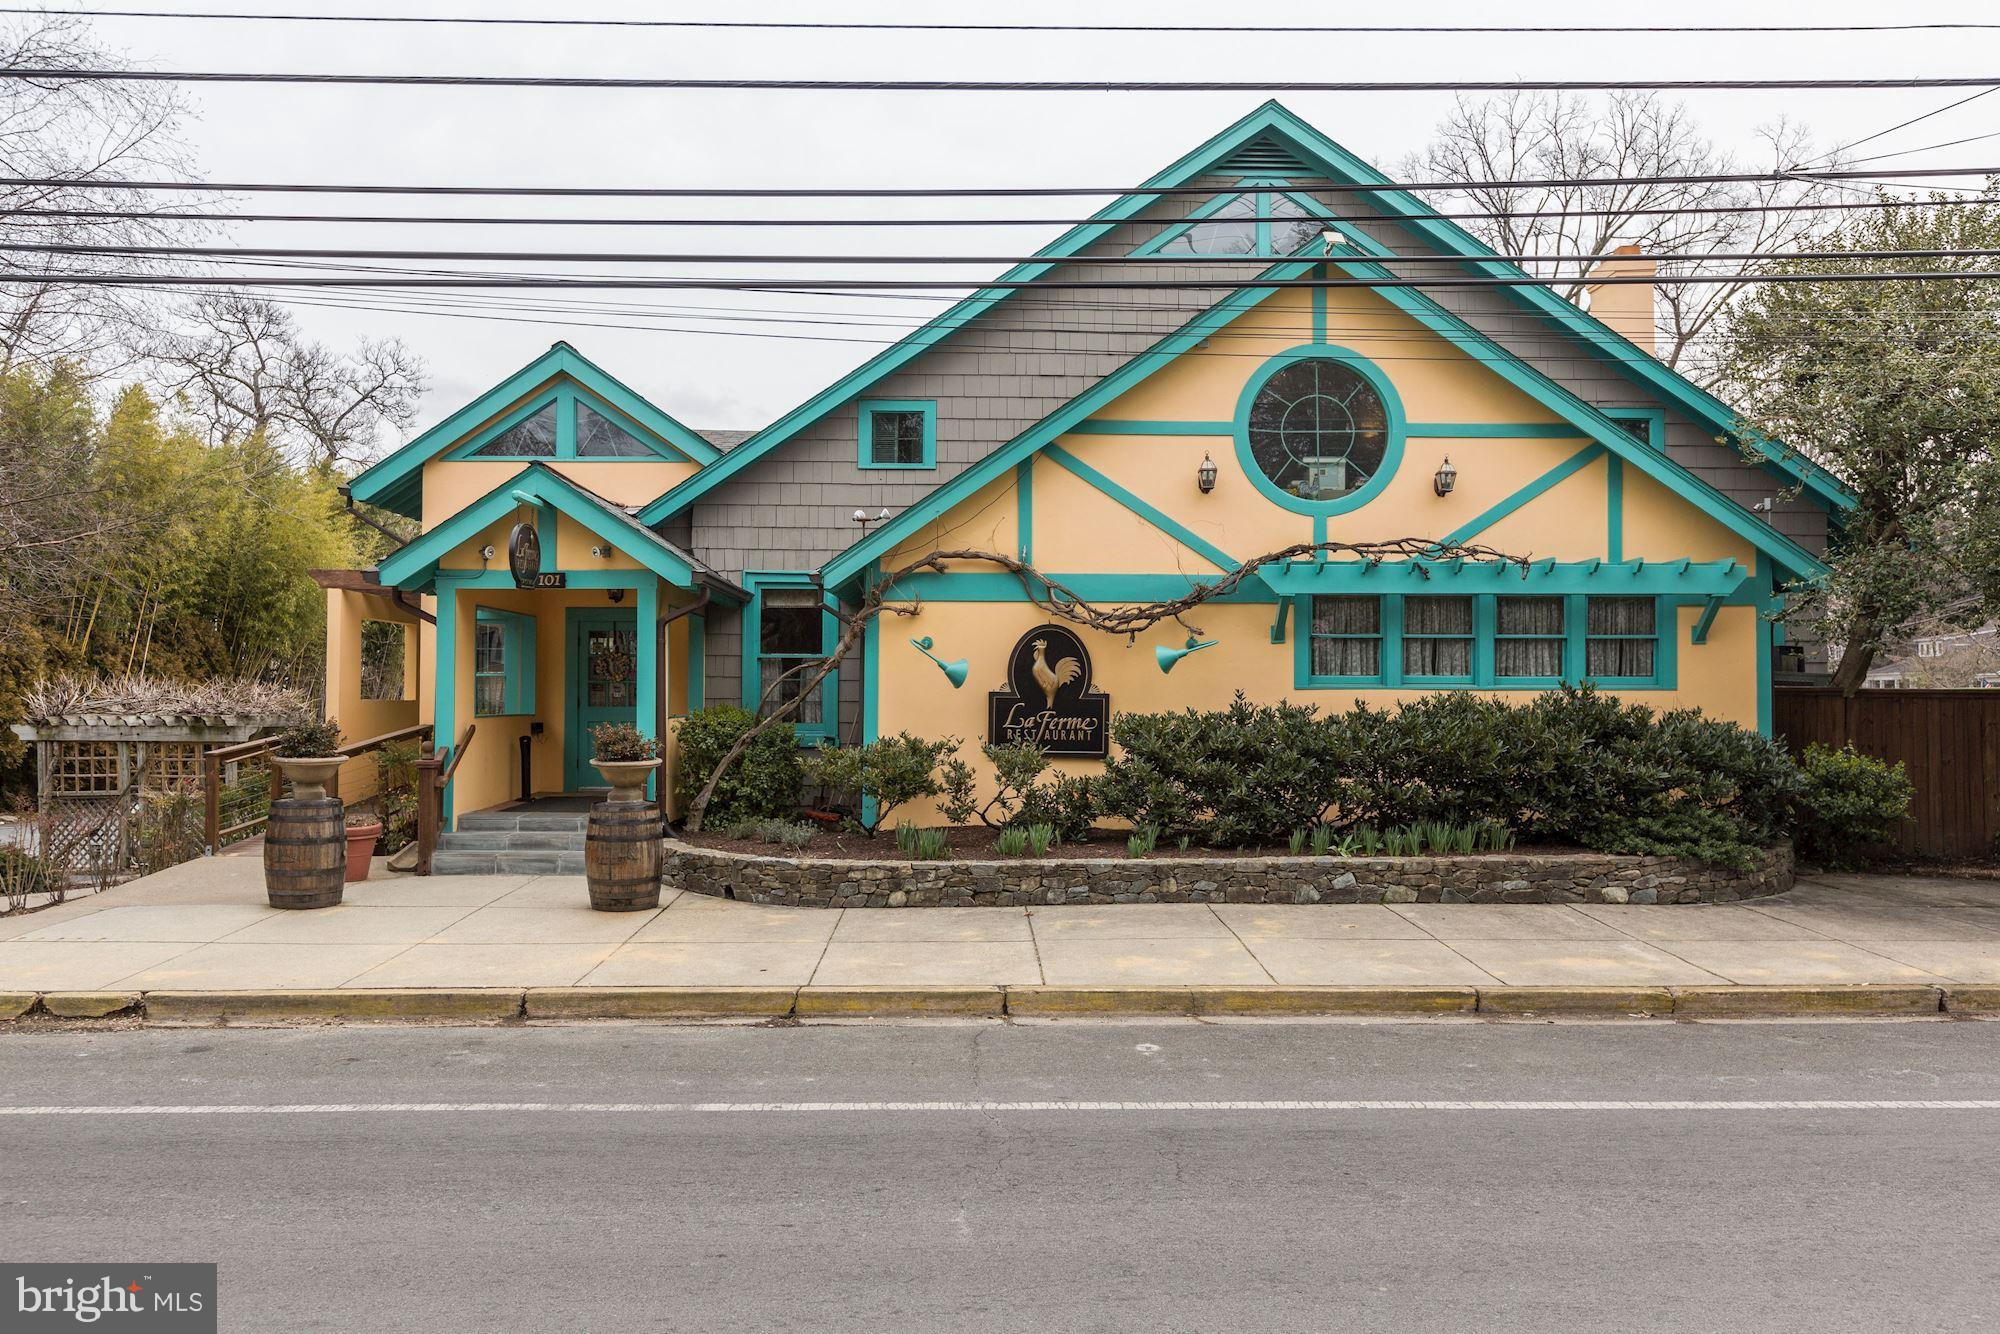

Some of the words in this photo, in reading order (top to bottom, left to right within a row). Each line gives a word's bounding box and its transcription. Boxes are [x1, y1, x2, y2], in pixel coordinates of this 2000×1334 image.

[538, 574, 561, 586] 101
[1003, 702, 1036, 728] La
[1036, 710, 1098, 745] Ferme
[1006, 728, 1093, 741] RESTAURANT
